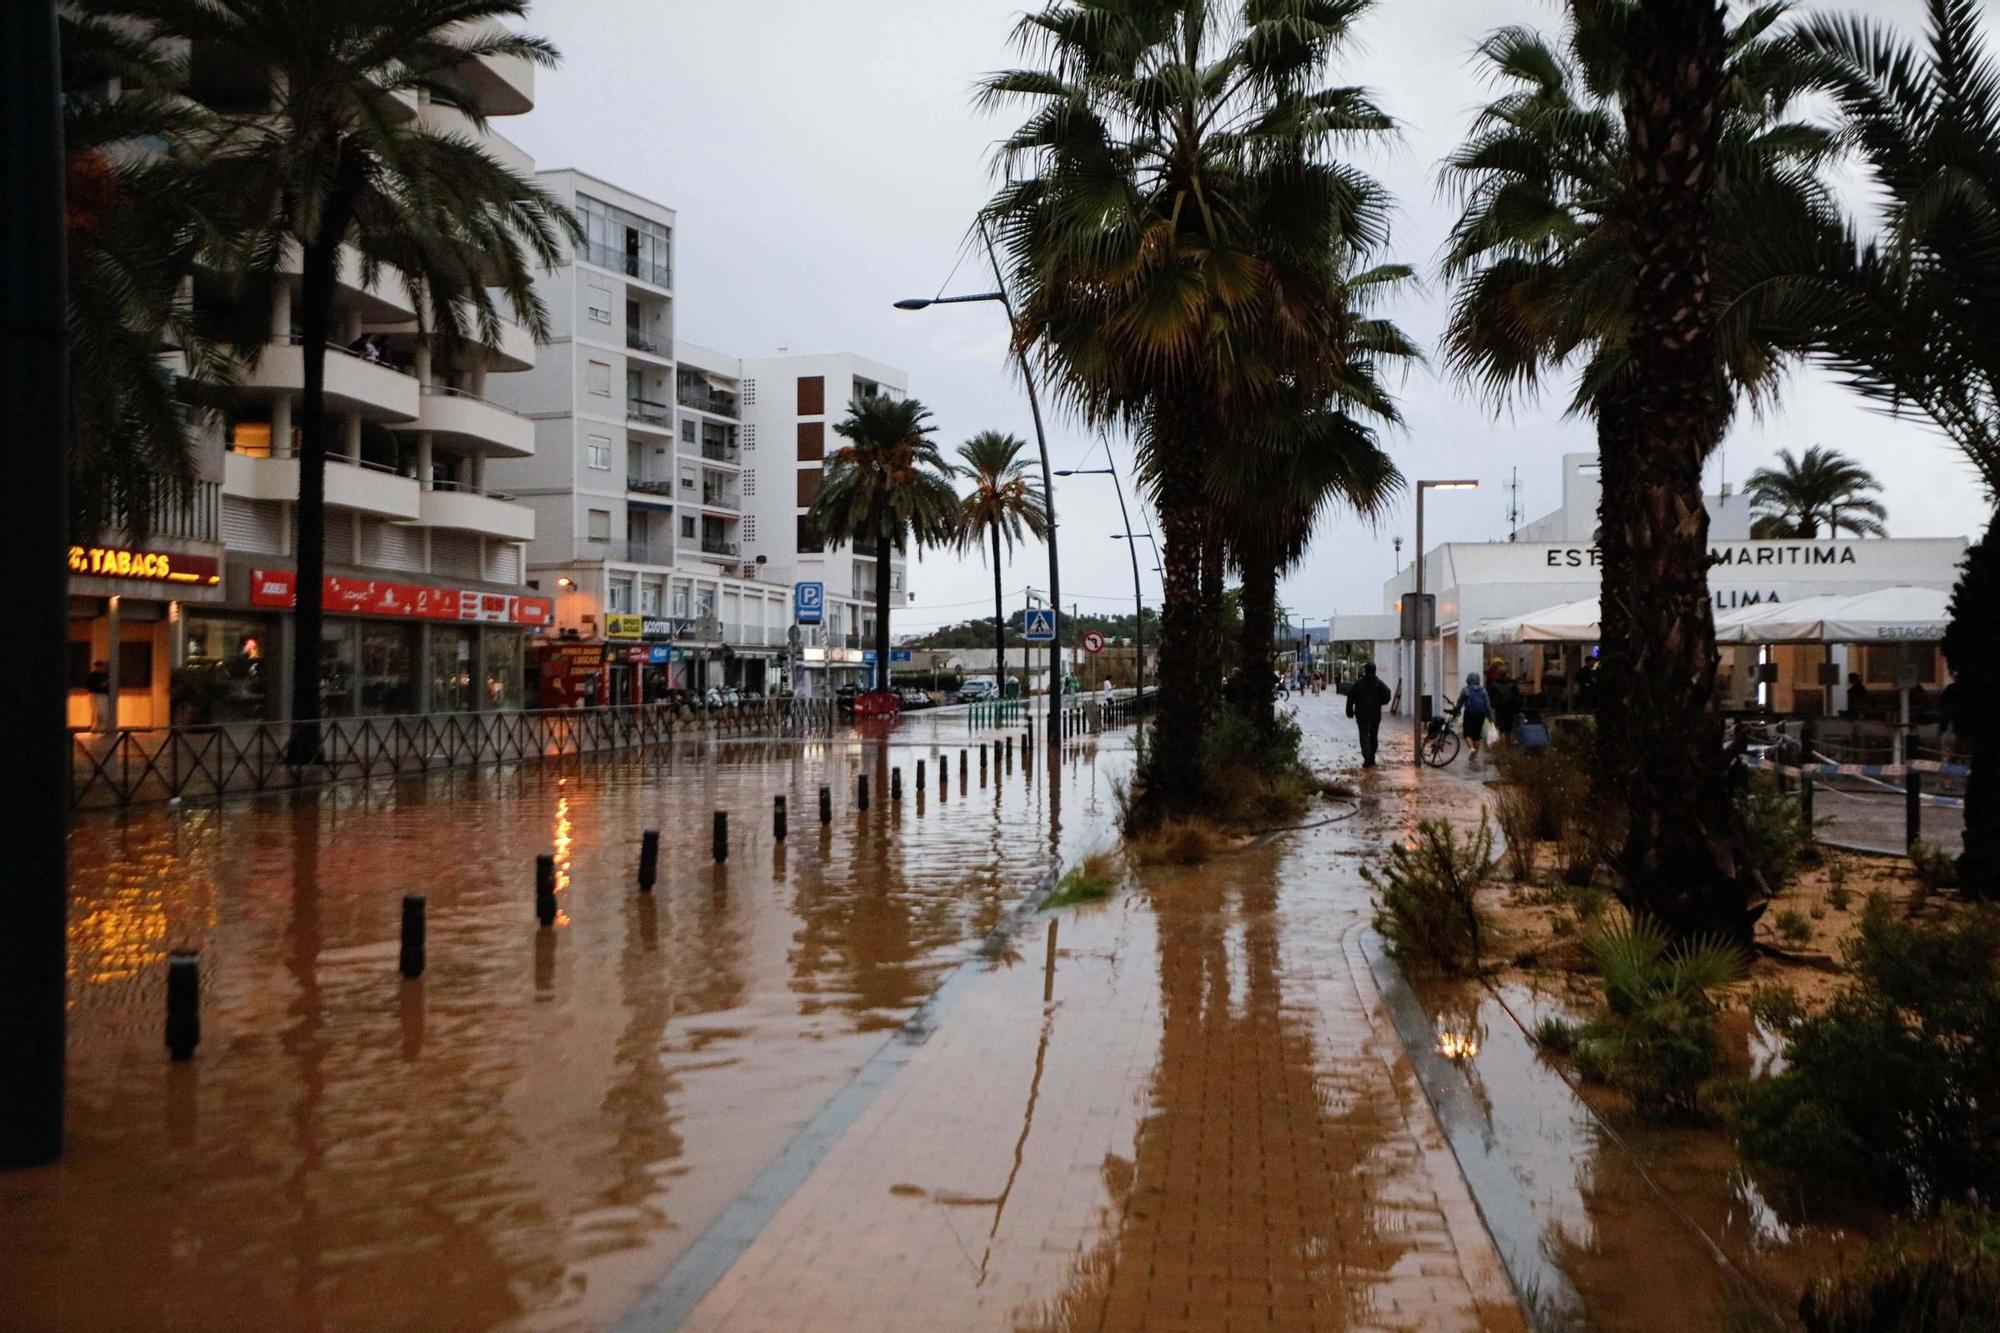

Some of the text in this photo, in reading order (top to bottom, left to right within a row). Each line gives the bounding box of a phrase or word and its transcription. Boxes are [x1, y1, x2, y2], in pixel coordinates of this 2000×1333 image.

[89, 549, 170, 578] TABACS
[1546, 545, 1857, 567] EST MARITIMA
[804, 587, 816, 605] P
